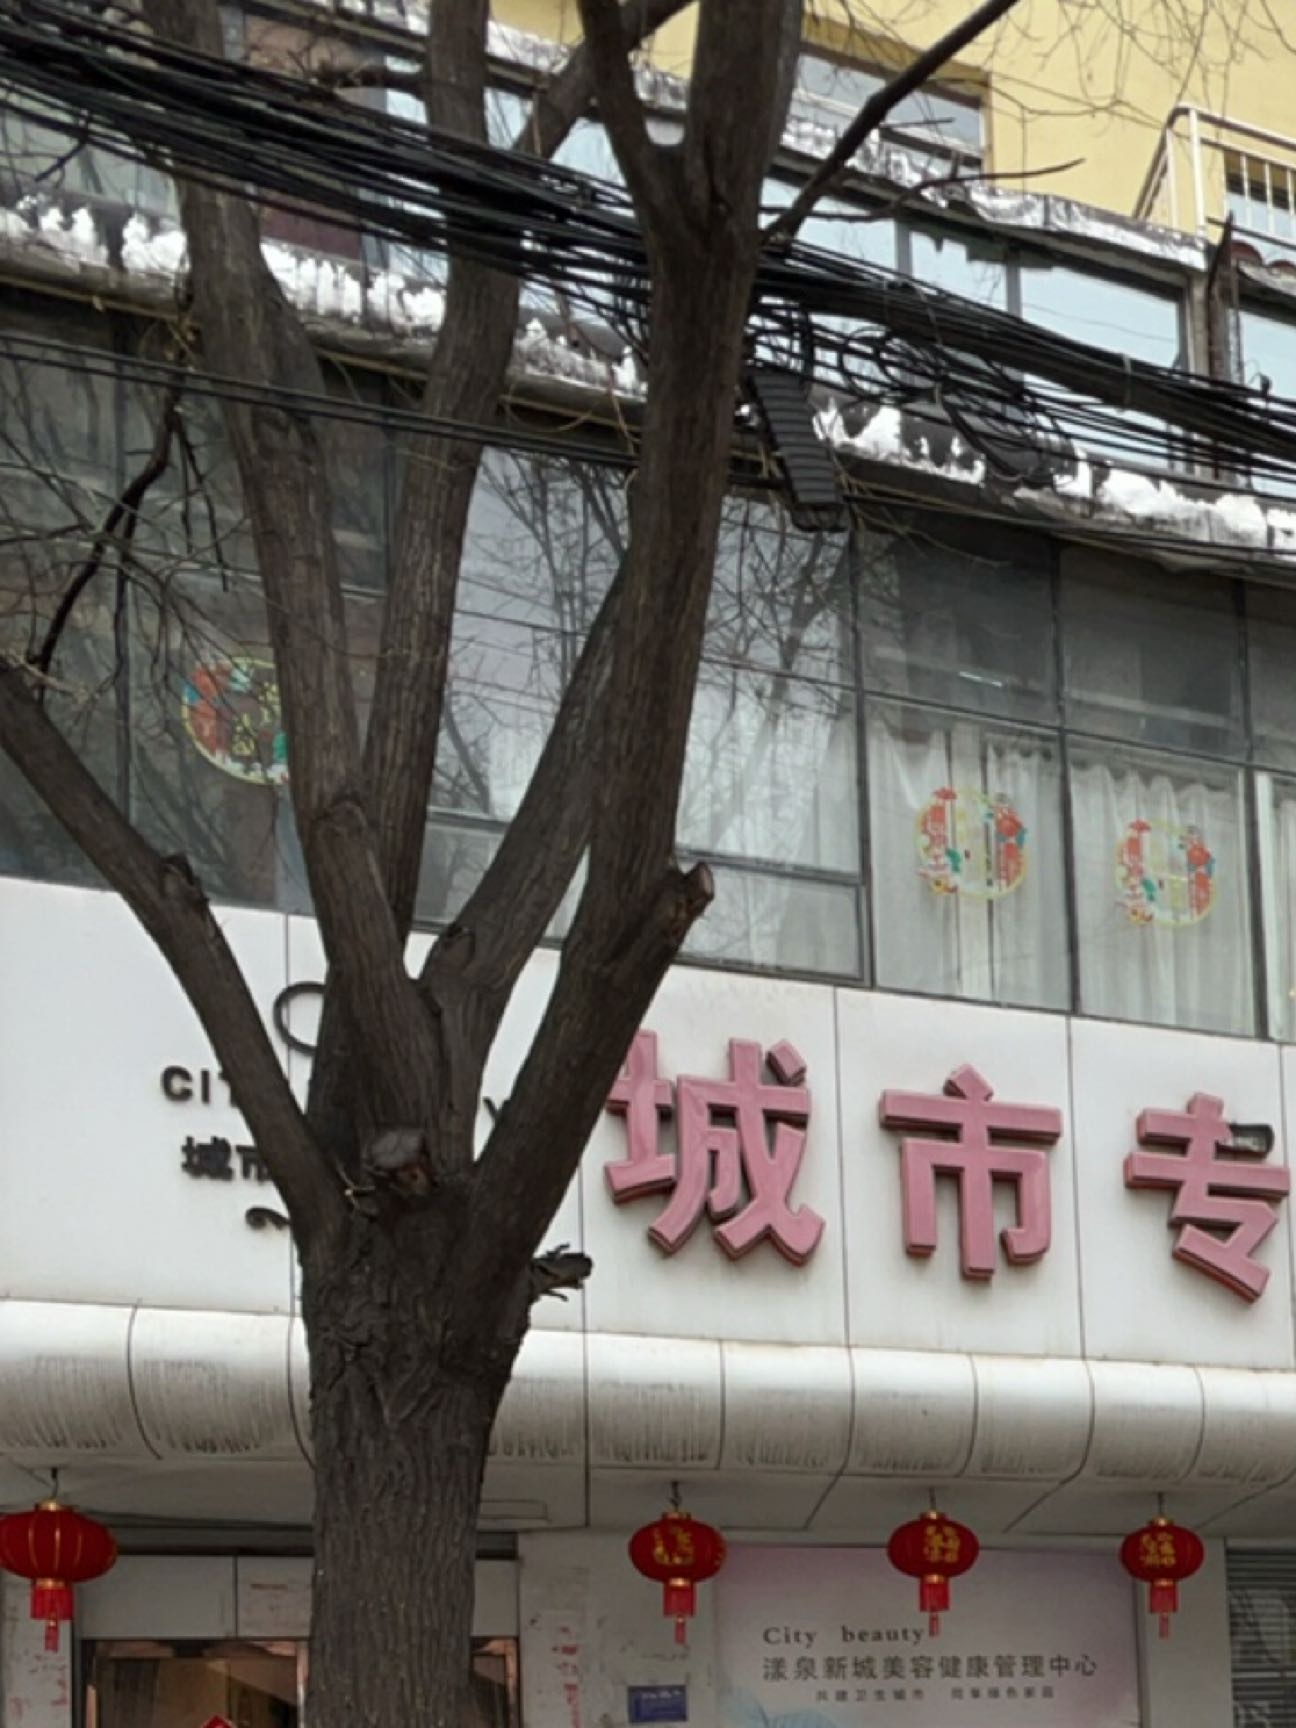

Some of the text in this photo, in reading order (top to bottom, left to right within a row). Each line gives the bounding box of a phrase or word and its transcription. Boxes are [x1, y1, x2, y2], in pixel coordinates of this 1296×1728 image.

[762, 1625, 925, 1648] City beauty
[762, 1655, 1097, 1681] 漾泉新城美容健康管理中心
